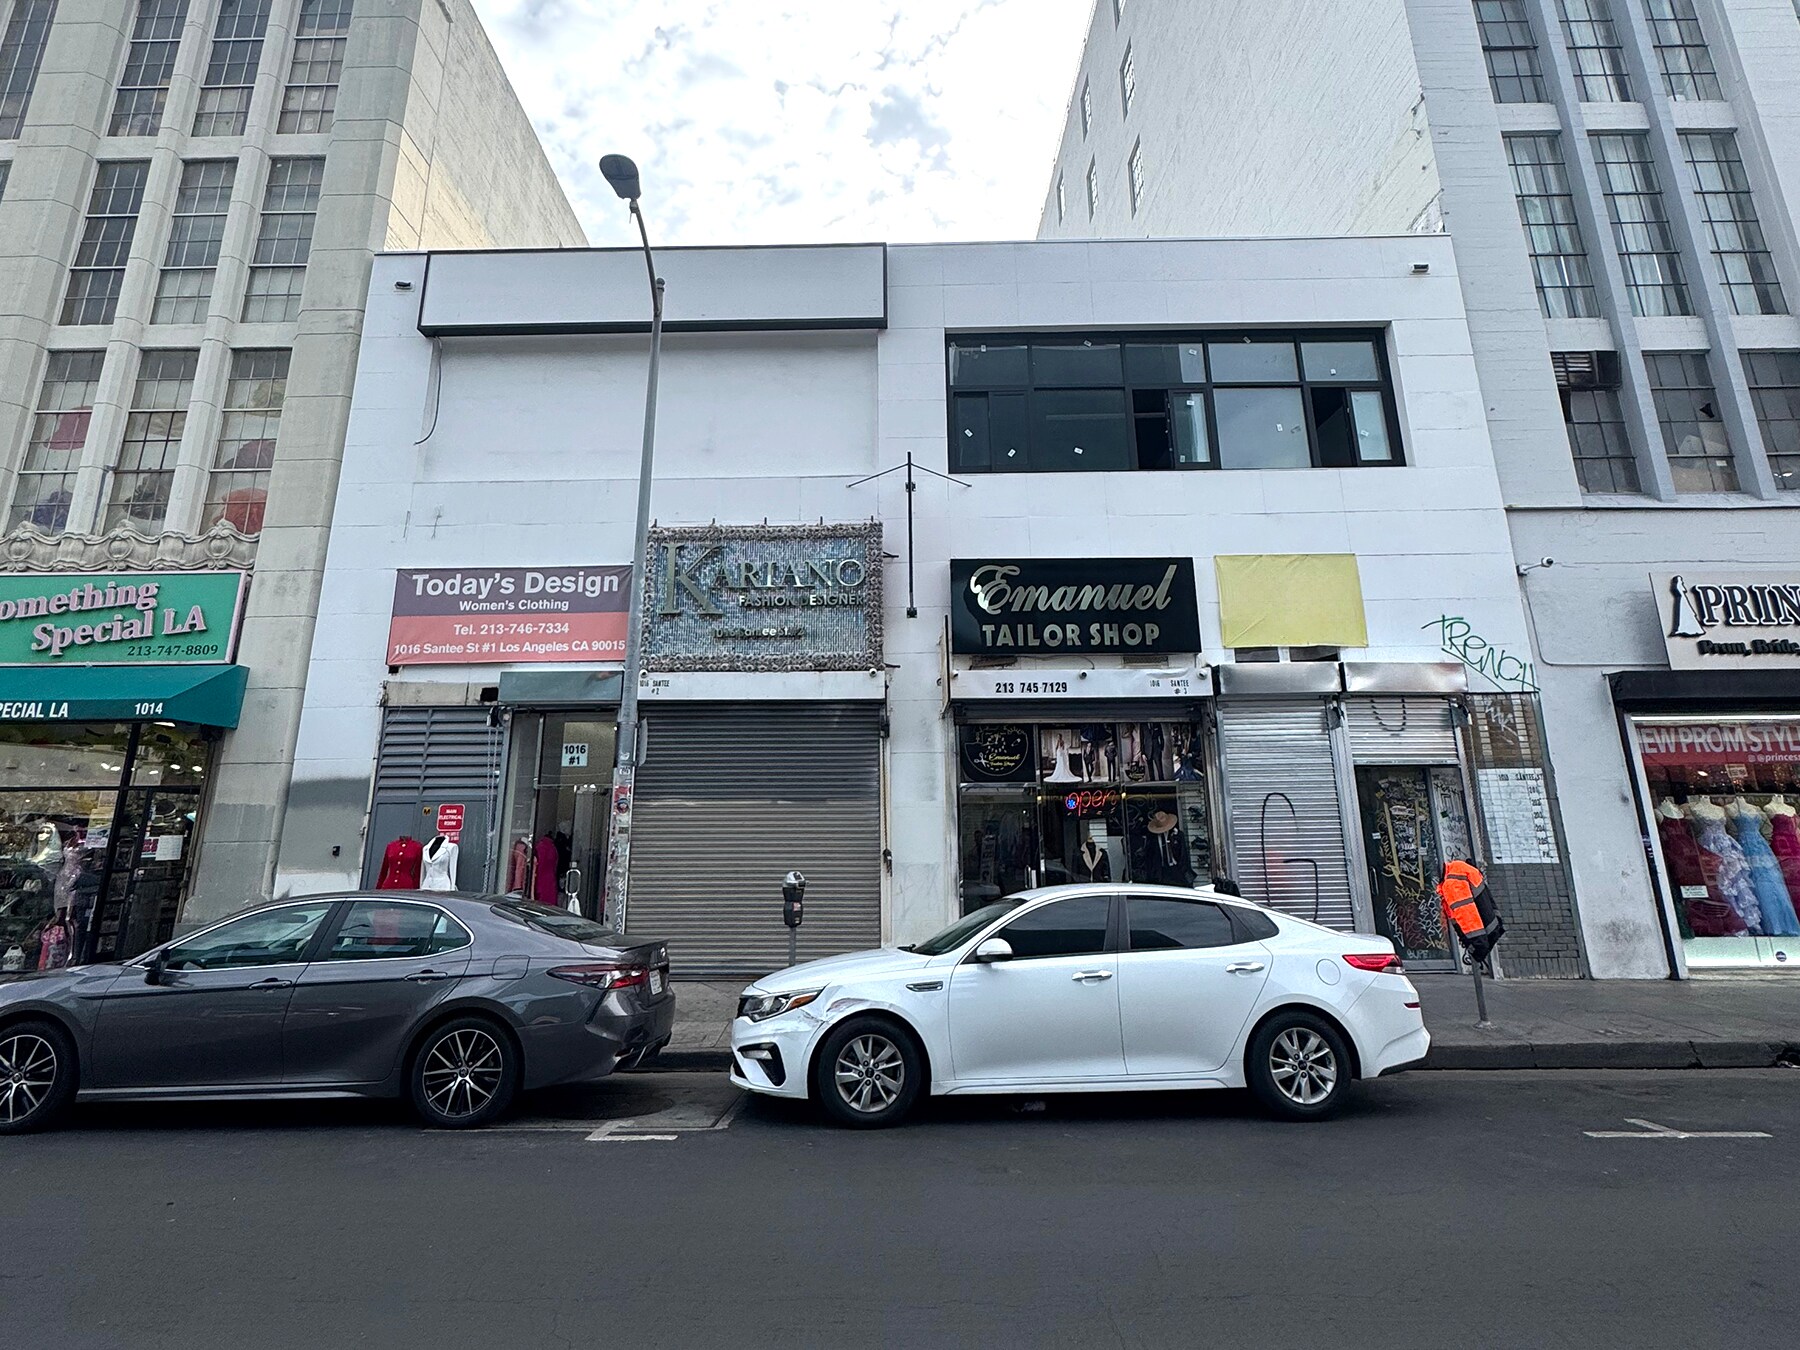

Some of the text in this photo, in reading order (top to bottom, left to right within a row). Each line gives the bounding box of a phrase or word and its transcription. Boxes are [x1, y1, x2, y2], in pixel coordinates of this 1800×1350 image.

[412, 571, 619, 599] Today's Design
[658, 542, 866, 616] KARIANO
[970, 565, 1177, 615] Emanuel
[459, 600, 569, 611] Women's Clothing
[739, 595, 793, 607] FASHION
[1694, 585, 1800, 626] PRIN
[31, 605, 207, 656] Special LA
[454, 623, 570, 635] Tel. 213-746-7334
[982, 623, 1160, 647] TAILOR SHOP
[127, 644, 219, 656] 213-747-8809
[394, 640, 626, 655] 1016 Santee St #1 Los Angeles CA 90015
[995, 683, 1014, 693] 213
[1170, 679, 1189, 687] SANTEE
[49, 702, 69, 718] LA
[135, 703, 163, 715] 1014
[1678, 726, 1748, 752] PROM
[1746, 725, 1800, 752] STYL
[564, 745, 586, 754] 1016
[568, 755, 581, 765] #1
